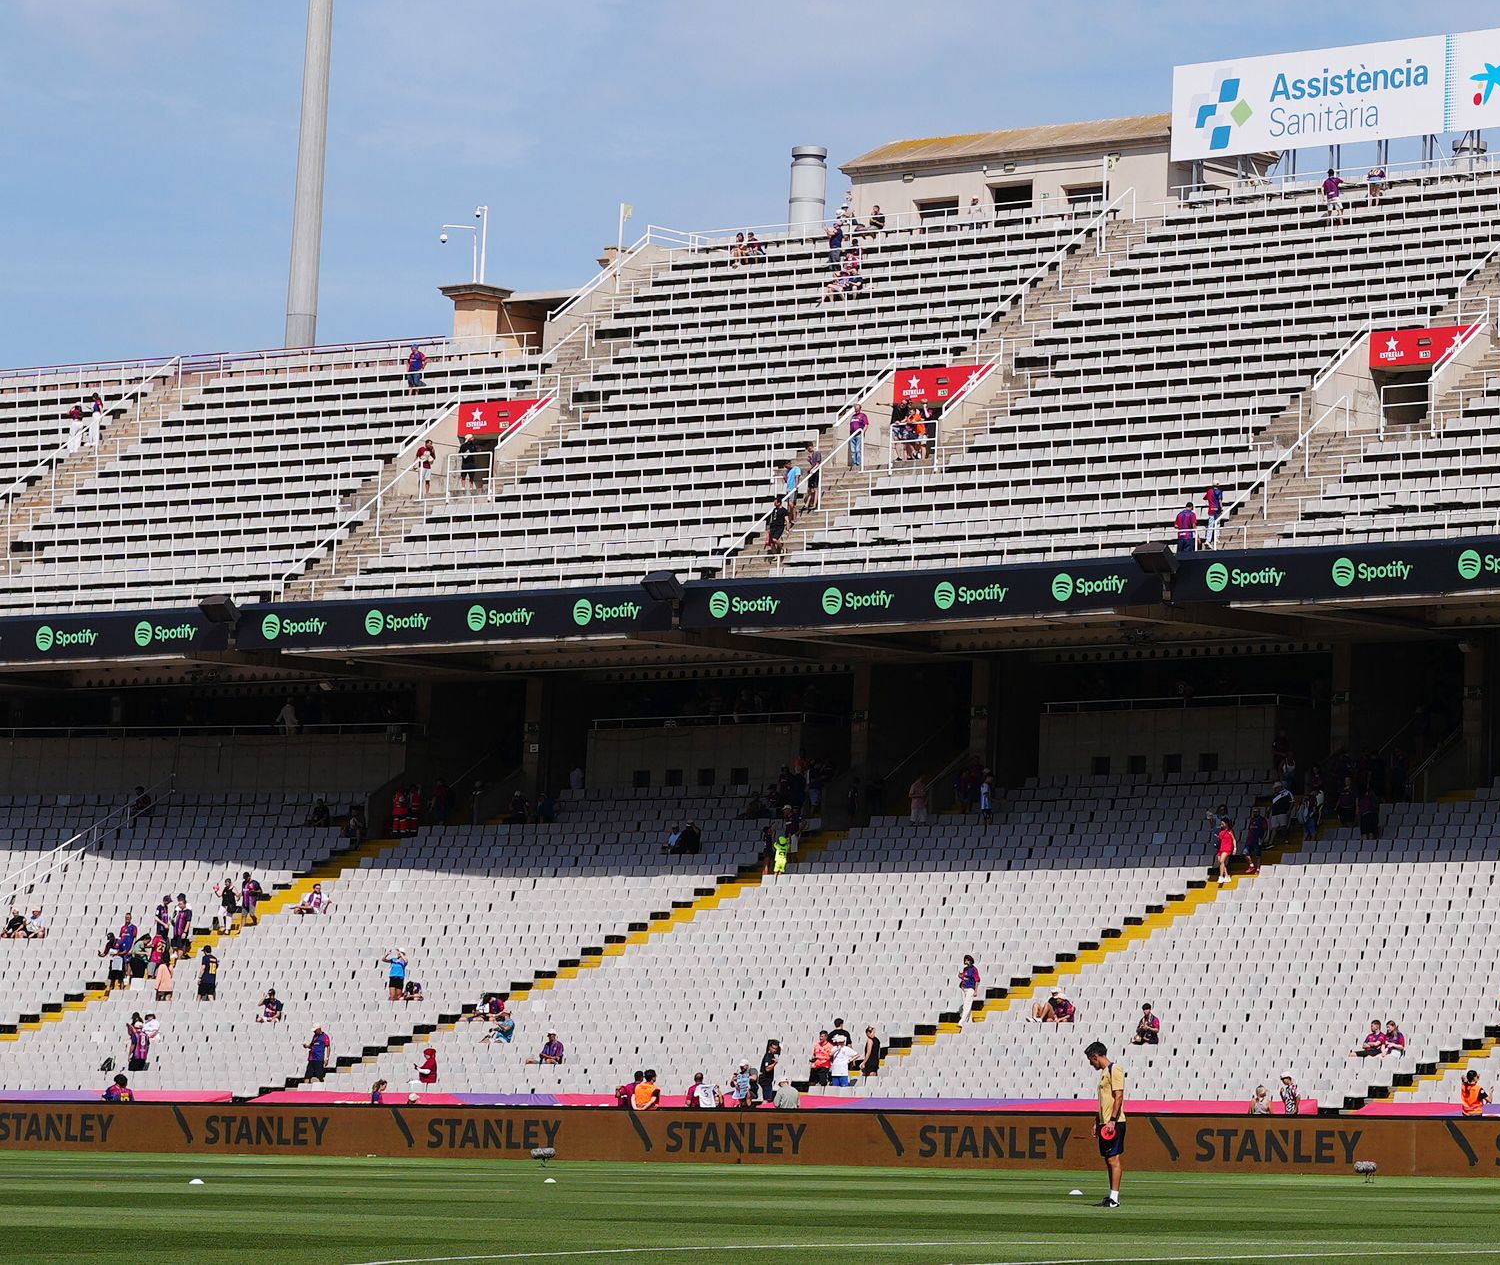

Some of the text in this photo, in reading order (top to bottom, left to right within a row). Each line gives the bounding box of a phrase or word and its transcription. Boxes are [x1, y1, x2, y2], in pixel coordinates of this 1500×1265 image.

[1269, 58, 1429, 103] Assistència
[1269, 99, 1379, 138] Sanitària
[1232, 568, 1285, 585] Spotify
[1358, 562, 1410, 580] Spotify
[959, 584, 1008, 603] Spotify
[1076, 576, 1126, 594] Spotify
[733, 596, 779, 613] Spotify
[846, 590, 893, 609] Spotify
[490, 608, 532, 625] Spotify
[595, 602, 641, 619] Spotify
[283, 618, 327, 633] Spotify
[386, 614, 429, 630] Spotify
[56, 629, 96, 645] Spotify
[155, 624, 197, 640] Spotify
[205, 1115, 329, 1146] STANLEY
[427, 1118, 560, 1150] STANLEY
[666, 1121, 806, 1154] STANLEY
[919, 1125, 1071, 1159] STANLEY
[1196, 1128, 1361, 1164] STANLEY
